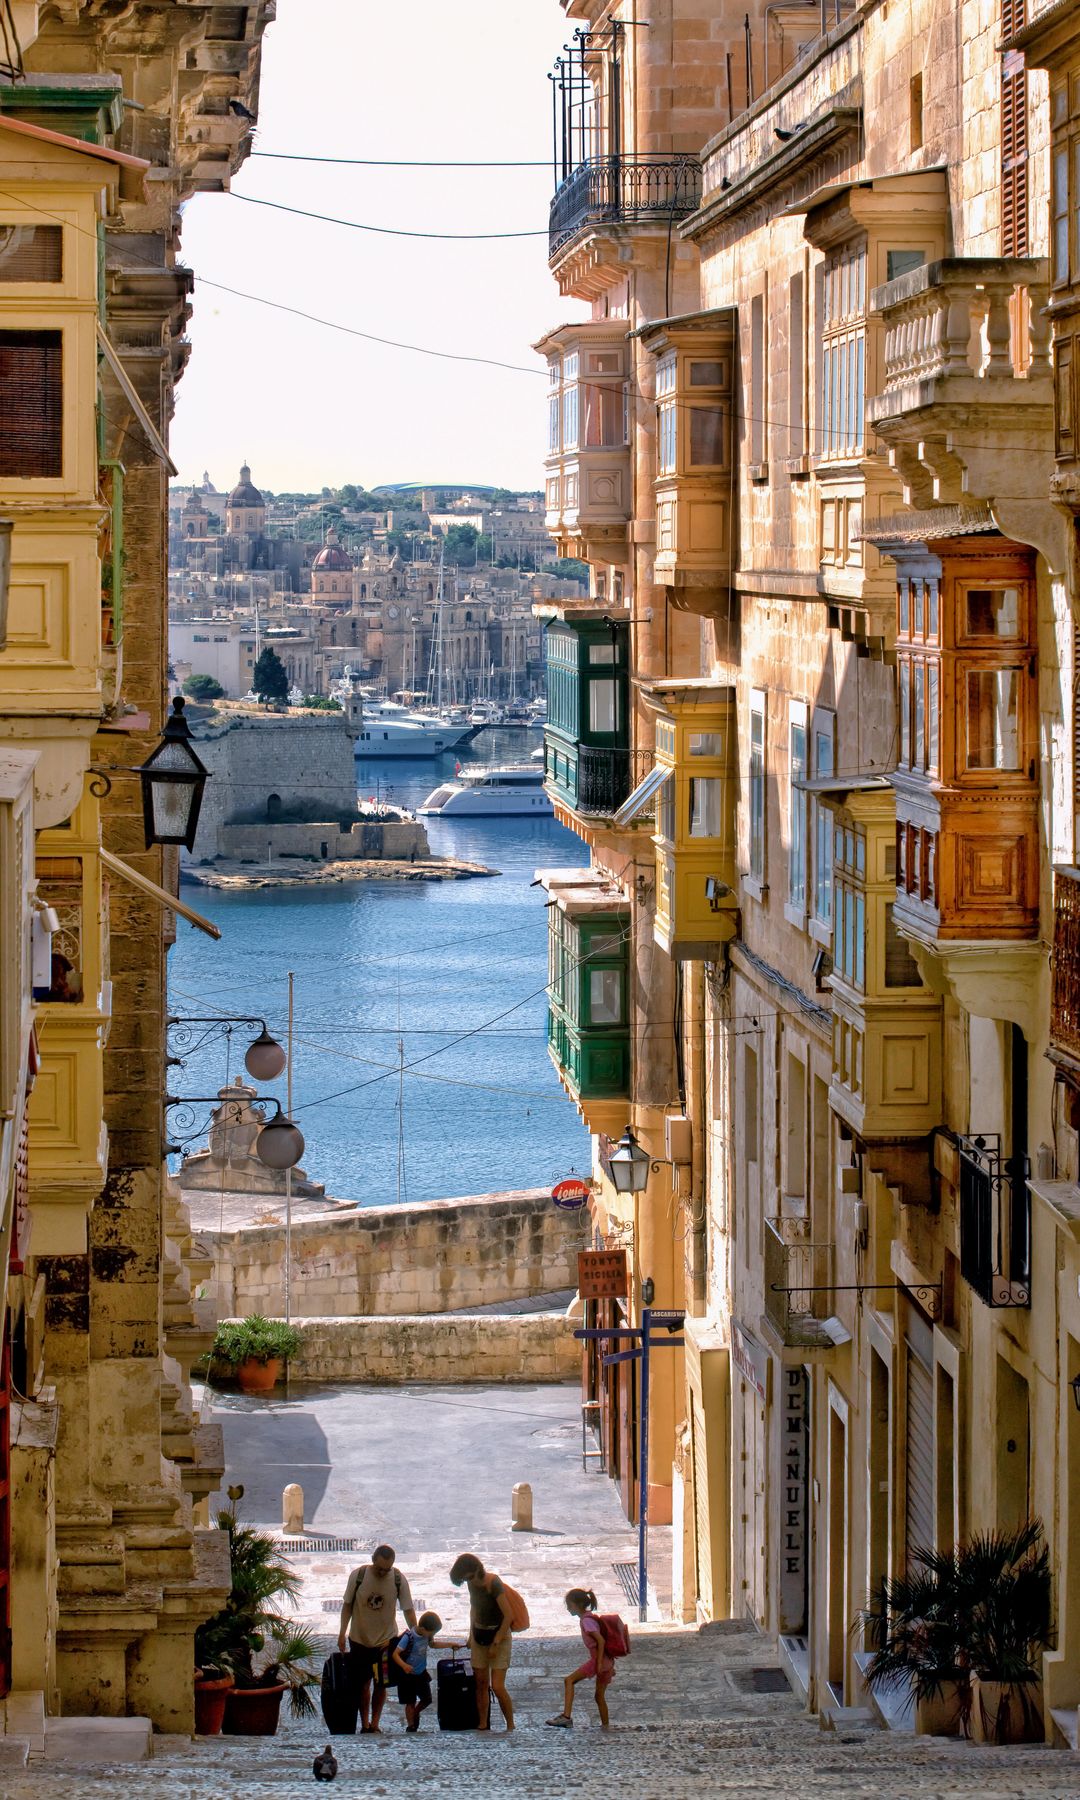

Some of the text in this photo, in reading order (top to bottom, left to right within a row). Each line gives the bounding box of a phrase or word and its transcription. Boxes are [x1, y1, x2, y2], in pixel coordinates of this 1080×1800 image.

[584, 1270, 622, 1279] SICILIA
[592, 1283, 616, 1292] BAR
[1007, 1439, 1016, 1453] 8
